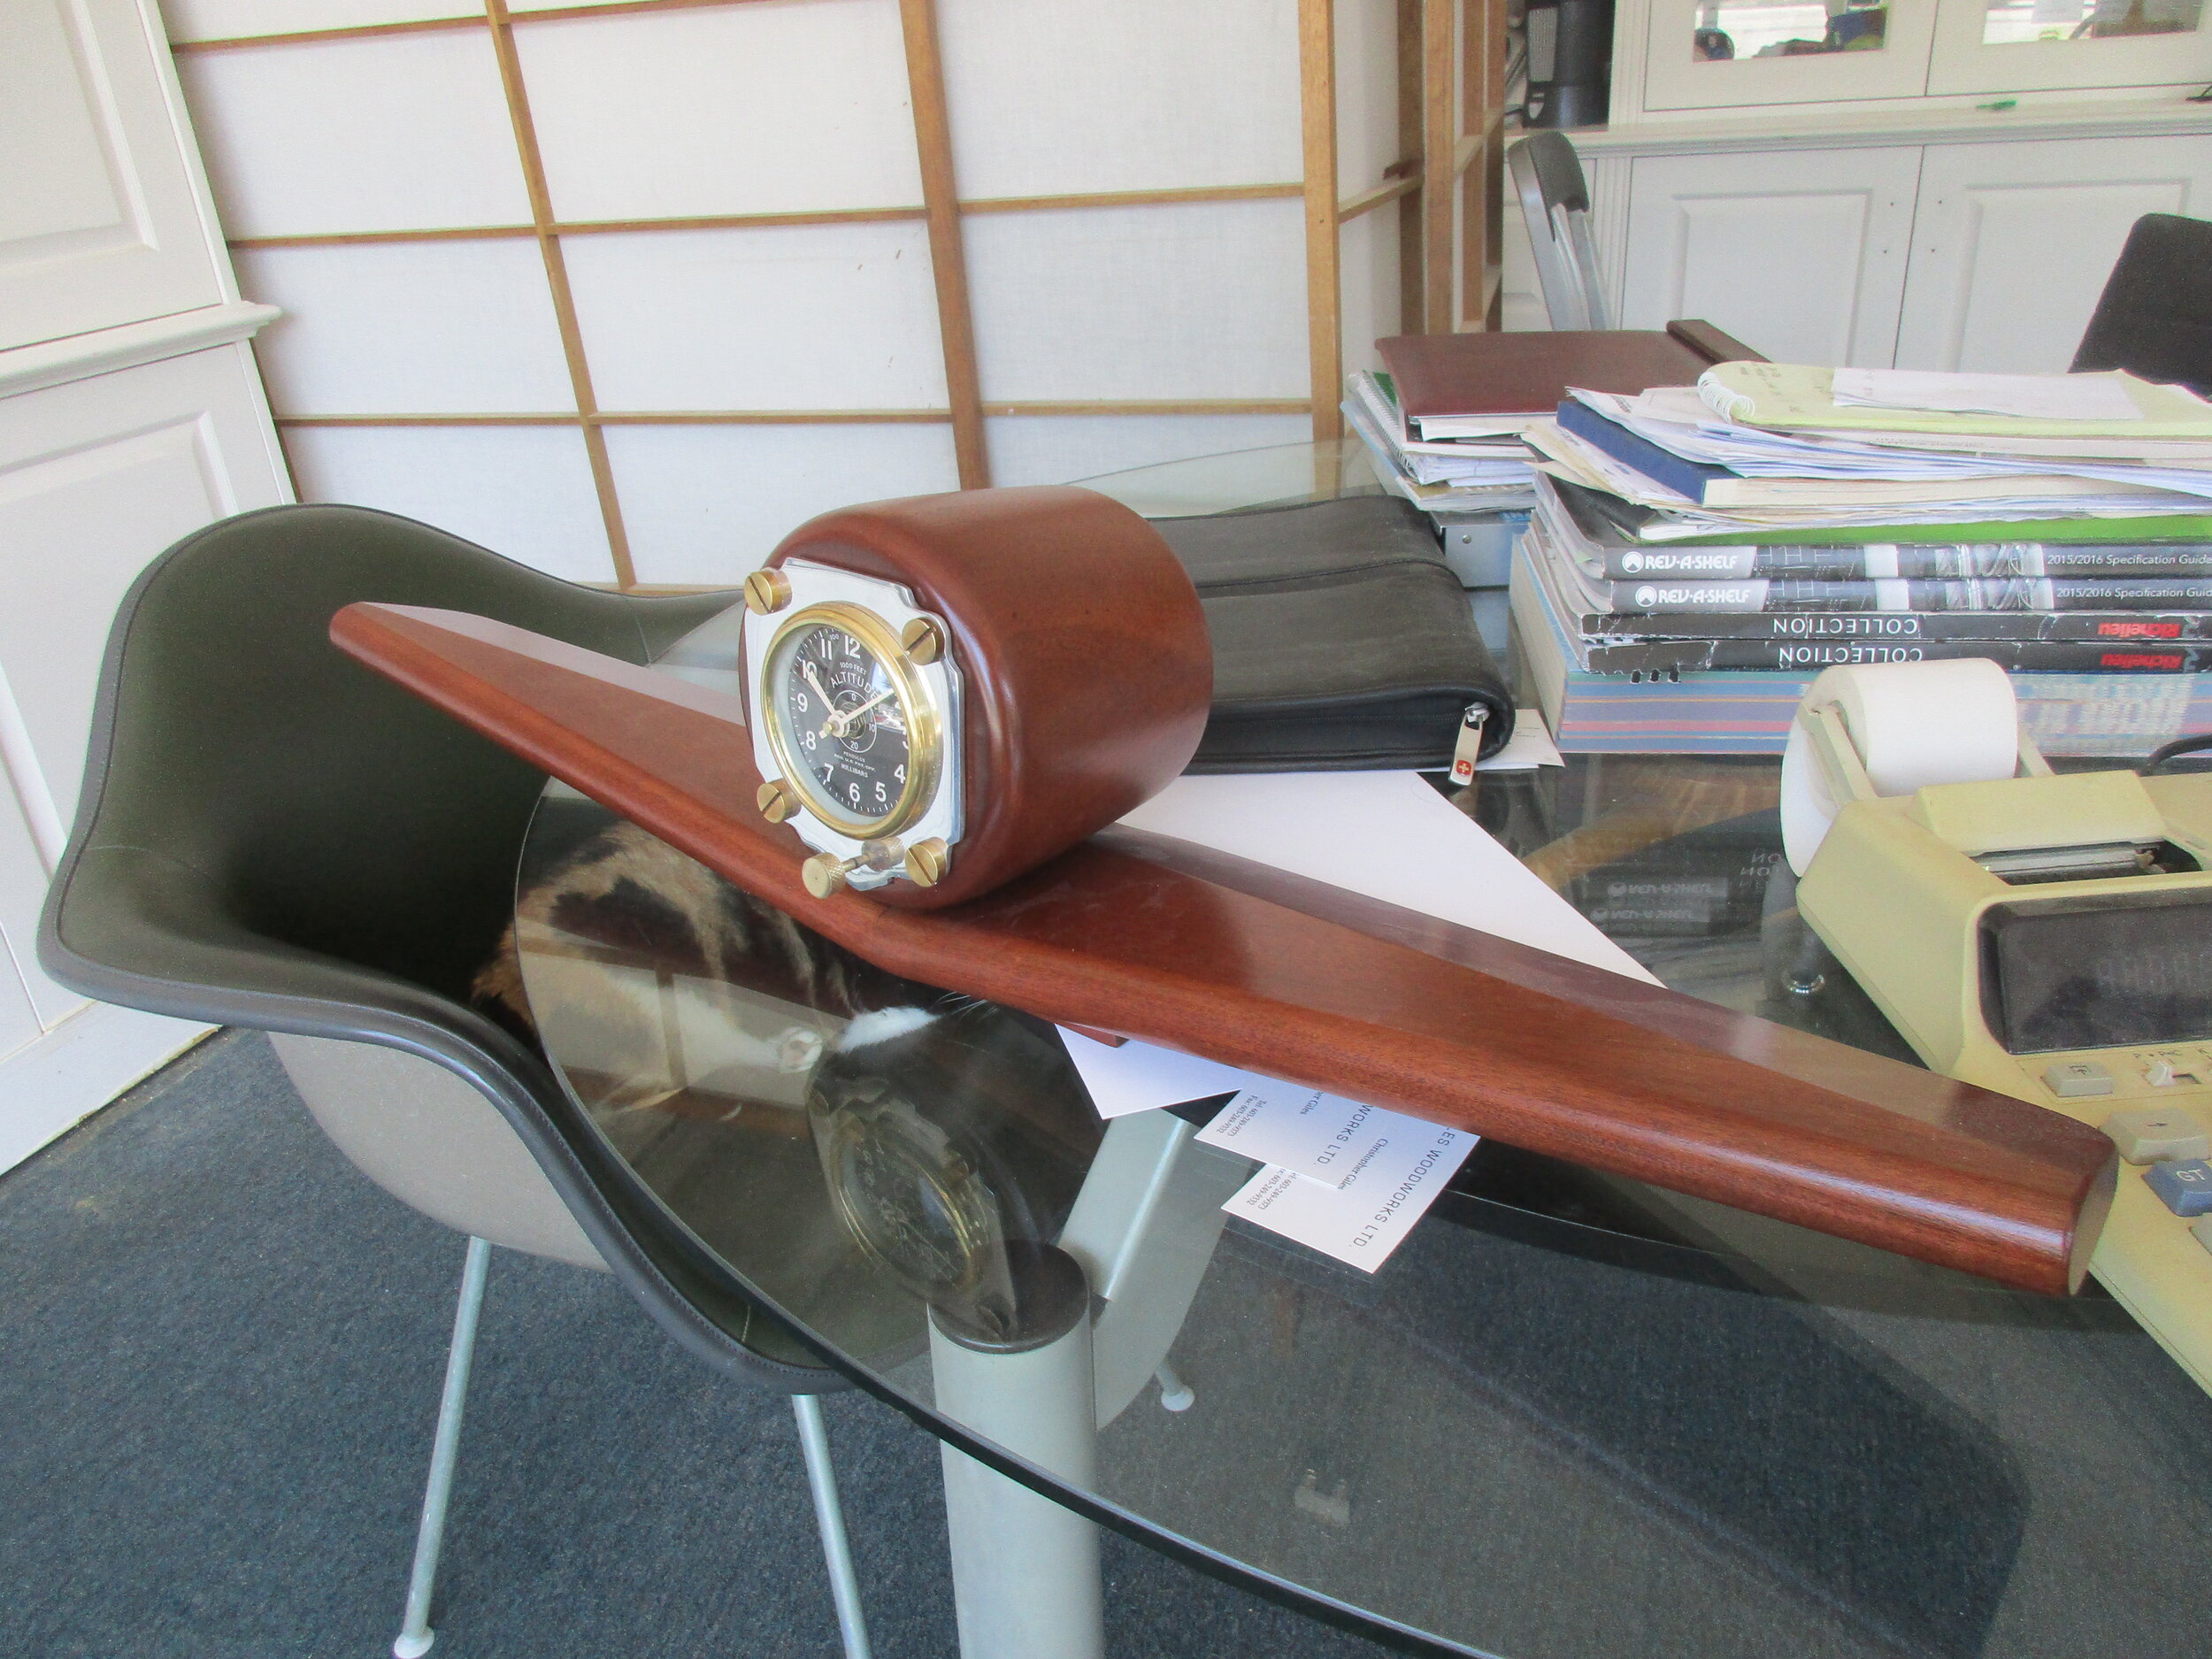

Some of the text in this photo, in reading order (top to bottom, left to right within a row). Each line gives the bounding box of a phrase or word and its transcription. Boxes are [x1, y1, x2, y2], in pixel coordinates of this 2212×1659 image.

[2047, 554, 2103, 565] 2015/2016
[2106, 554, 2176, 567] Specification
[2056, 588, 2112, 598] 2015/2016
[2114, 588, 2183, 600] Specification
[1772, 617, 1918, 634] COLLECTION
[2097, 622, 2181, 639] Richelieu
[830, 633, 840, 641] 100
[845, 634, 862, 659] 12
[821, 638, 833, 661] 11
[1777, 645, 1924, 662] COLLECTION
[803, 659, 818, 680] 10
[840, 661, 867, 676] 1000 FEET
[830, 670, 879, 700] ALTITUDE
[796, 692, 809, 713] 9
[868, 723, 876, 733] 10
[805, 730, 817, 751] 8
[850, 740, 859, 750] 20
[824, 763, 834, 783] 7
[841, 763, 869, 779] MILLIBARS
[894, 764, 906, 785] 4
[849, 782, 861, 803] 6
[875, 781, 887, 803] 5
[1300, 1100, 1318, 1115] Giles
[1313, 1103, 1374, 1165] WORKS LTD.
[1437, 1127, 1455, 1146] ES
[1352, 1138, 1388, 1175] Christopher
[2176, 1169, 2206, 1182] GT
[1374, 1149, 1443, 1223] WOODWORKS
